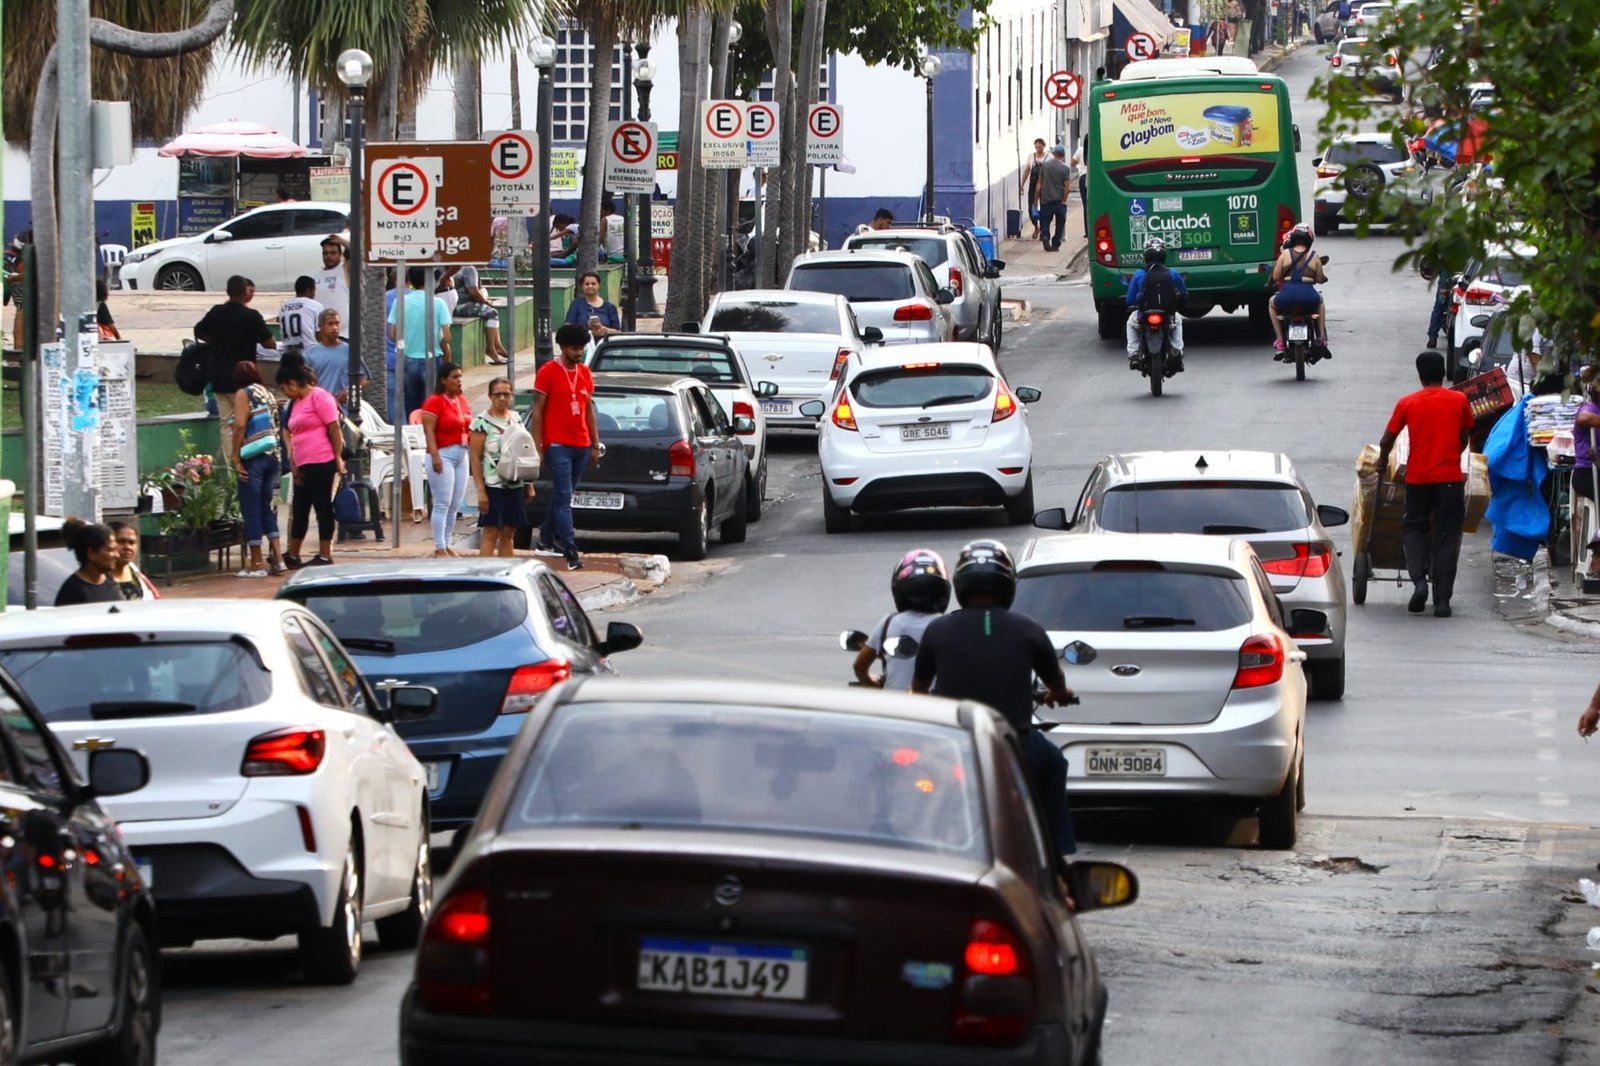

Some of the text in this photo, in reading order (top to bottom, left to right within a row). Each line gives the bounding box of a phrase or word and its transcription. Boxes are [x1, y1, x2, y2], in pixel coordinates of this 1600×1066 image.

[1120, 101, 1146, 115] Mais
[1128, 112, 1146, 123] que
[716, 110, 732, 131] E
[751, 111, 765, 132] E
[818, 112, 831, 131] E
[623, 131, 641, 155] E
[1120, 124, 1174, 150] Claybom
[500, 142, 520, 170] E
[658, 156, 675, 168] RO
[392, 174, 413, 204] E
[1227, 195, 1257, 210] 1070
[377, 219, 429, 229] MOTOTÁXI
[1148, 213, 1211, 231] Cuiabá
[436, 236, 470, 254] nga
[1184, 232, 1212, 244] 300
[281, 314, 301, 339] 10
[651, 954, 790, 993] KAB1J49
